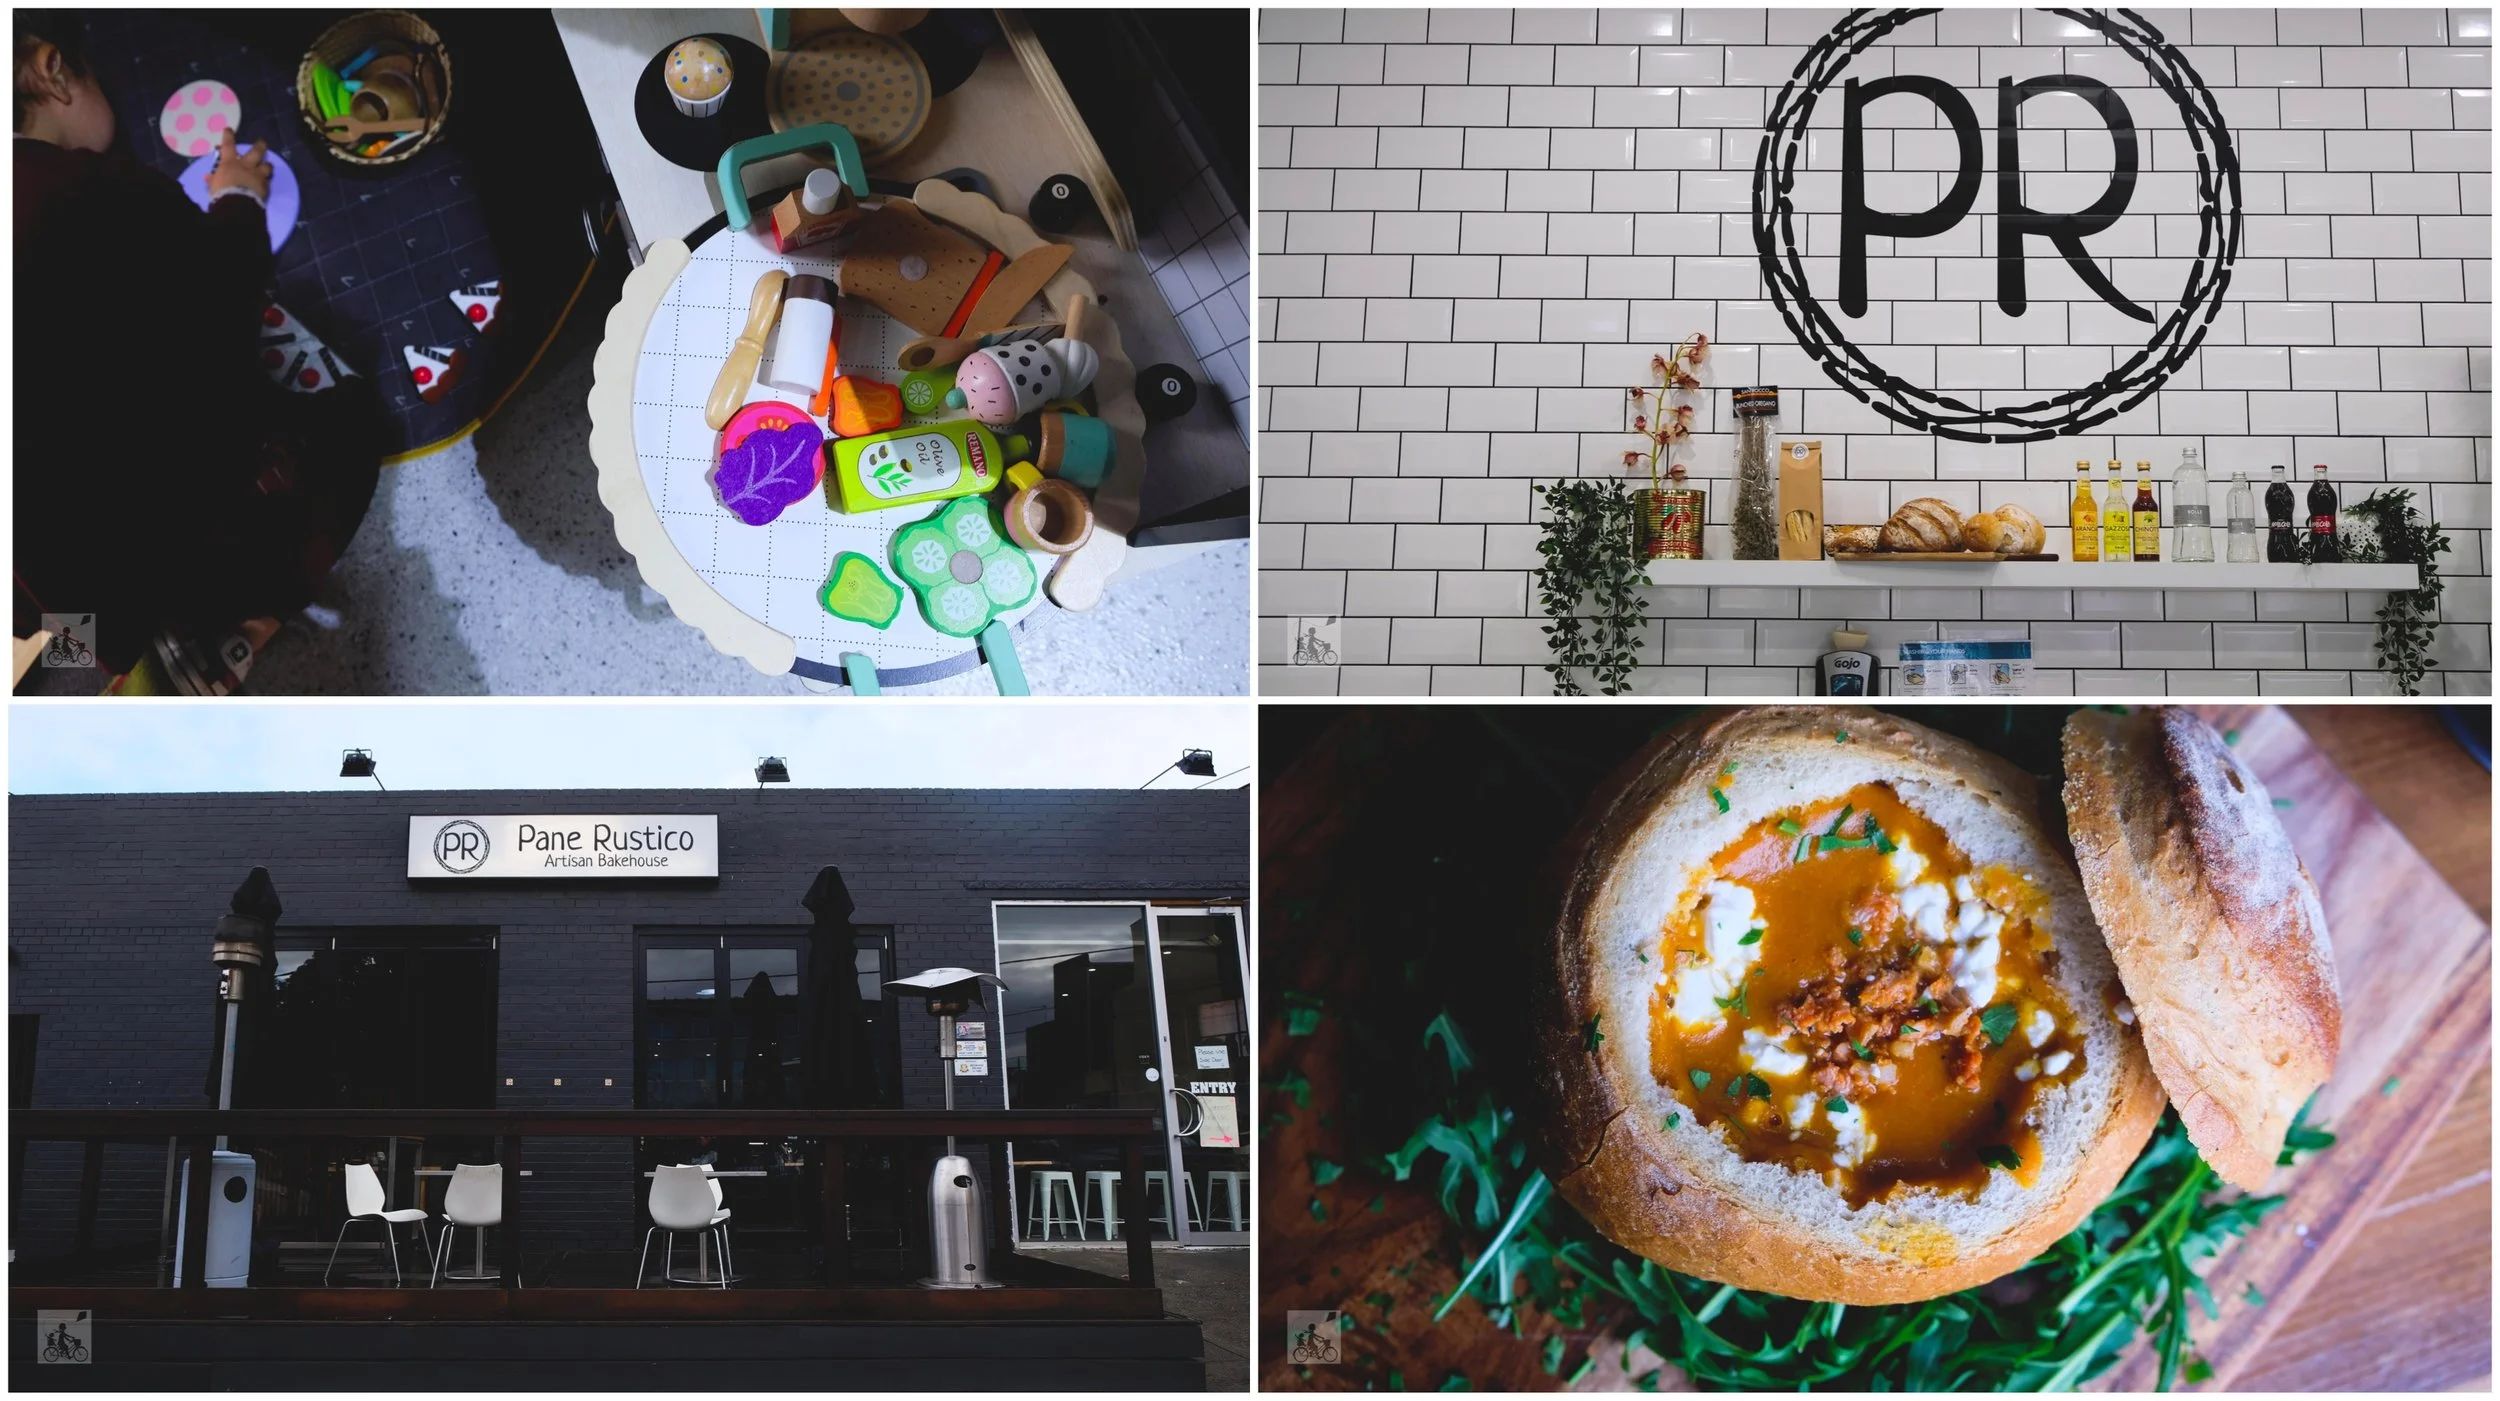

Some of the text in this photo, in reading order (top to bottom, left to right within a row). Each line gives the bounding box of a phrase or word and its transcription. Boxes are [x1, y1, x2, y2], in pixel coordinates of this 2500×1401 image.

[1838, 74, 2157, 324] PR
[916, 441, 931, 465] Oil
[930, 439, 945, 476] Olive
[967, 433, 986, 477] REMANO
[443, 831, 479, 861] PR
[518, 823, 695, 852] Pane Rustico
[544, 853, 669, 868] Artisan Bakehouse
[1190, 1082, 1236, 1094] ENTRY
